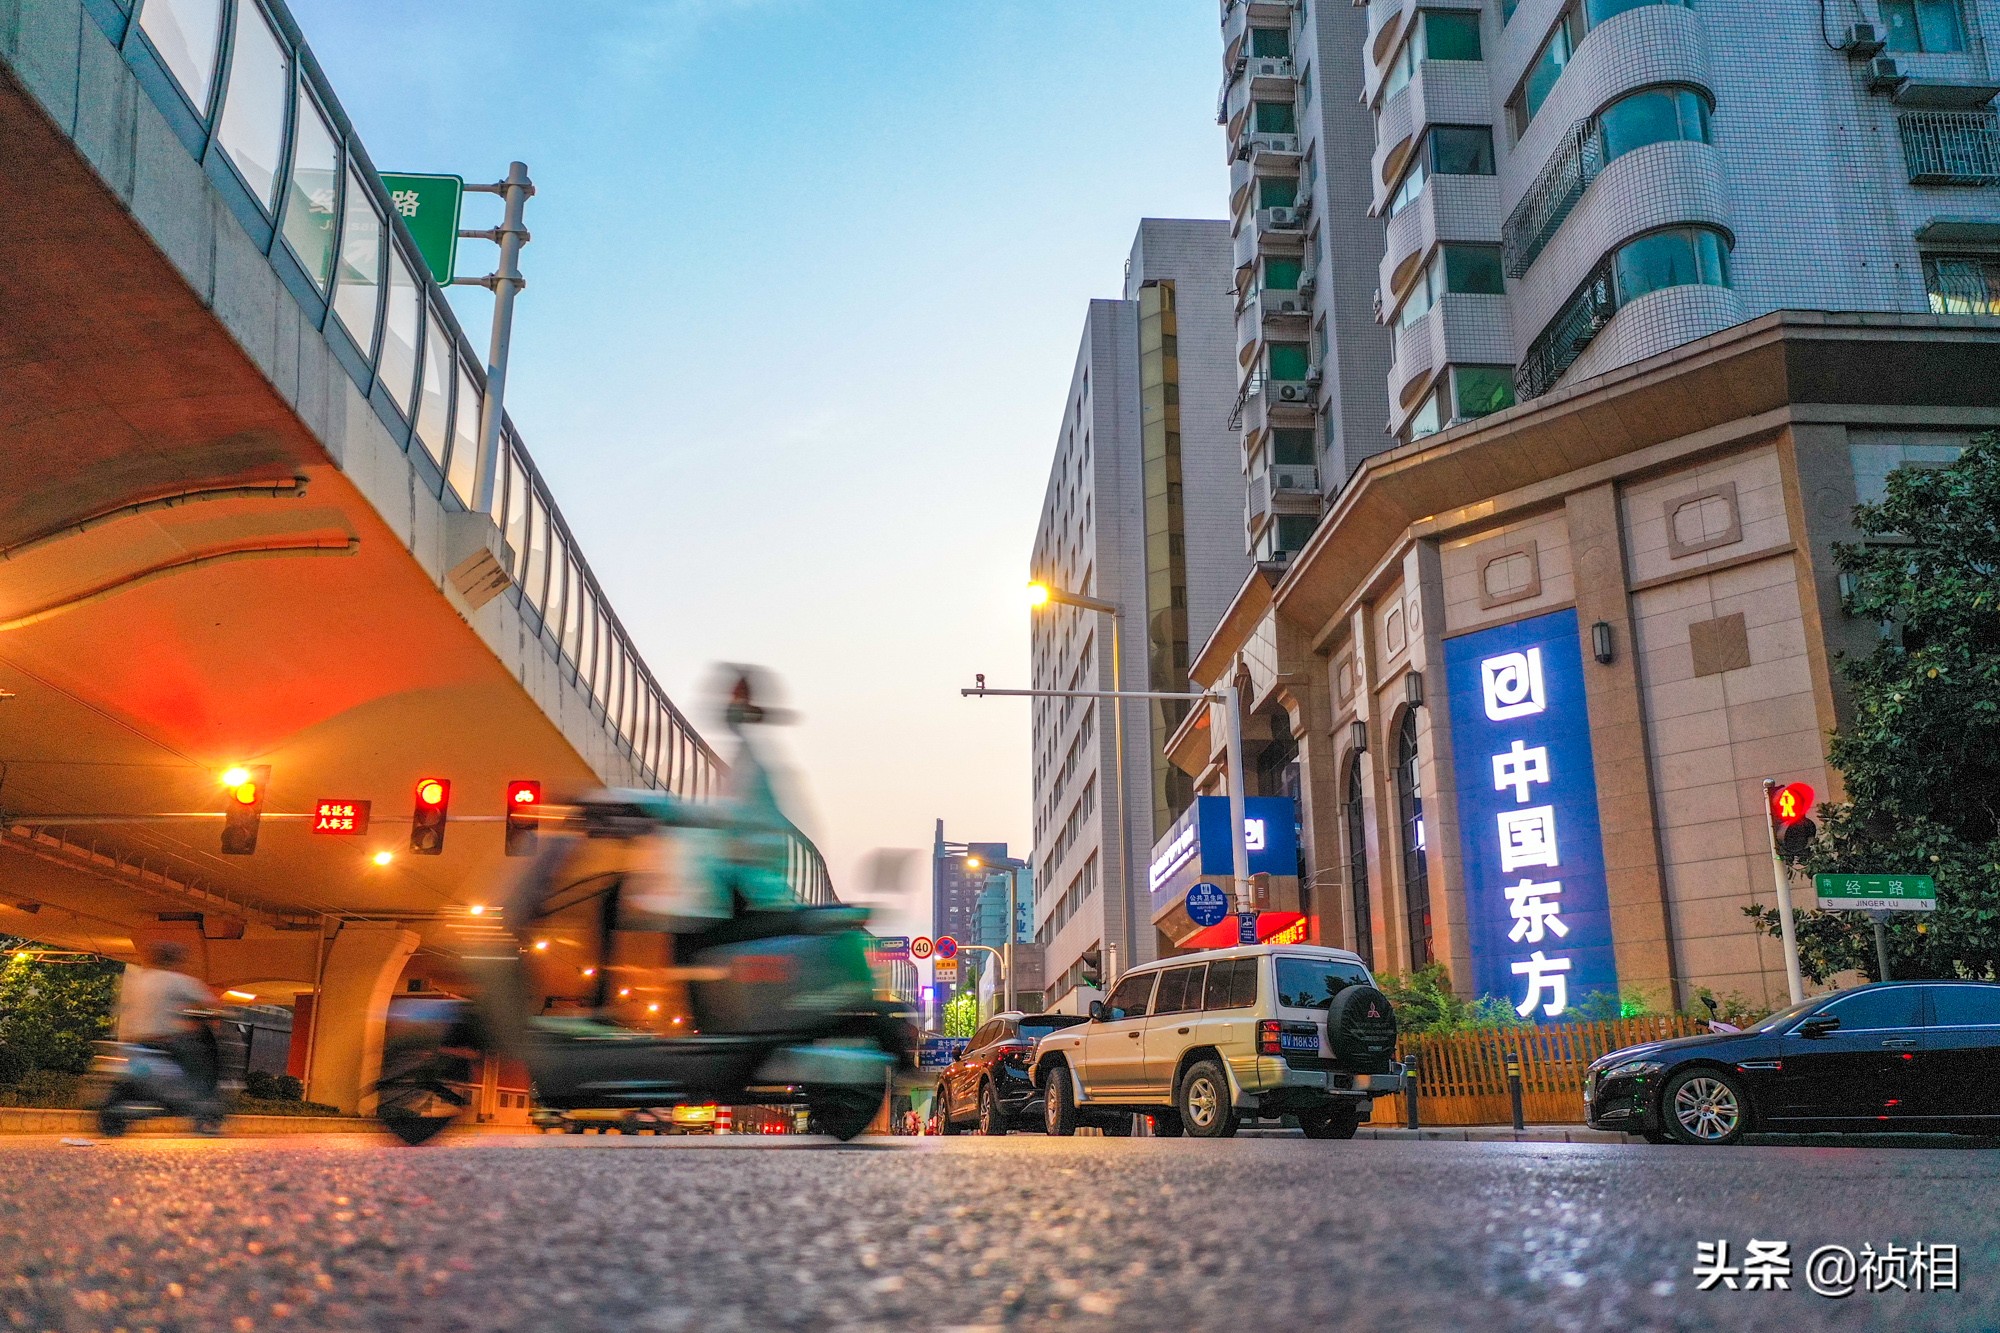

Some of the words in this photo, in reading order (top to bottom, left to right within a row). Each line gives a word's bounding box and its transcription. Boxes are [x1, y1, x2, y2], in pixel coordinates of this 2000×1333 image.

[1491, 739, 1572, 1018] 中国东方
[1845, 879, 1905, 896] 经二路
[1189, 894, 1224, 902] 公共卫生间
[915, 942, 929, 953] 40
